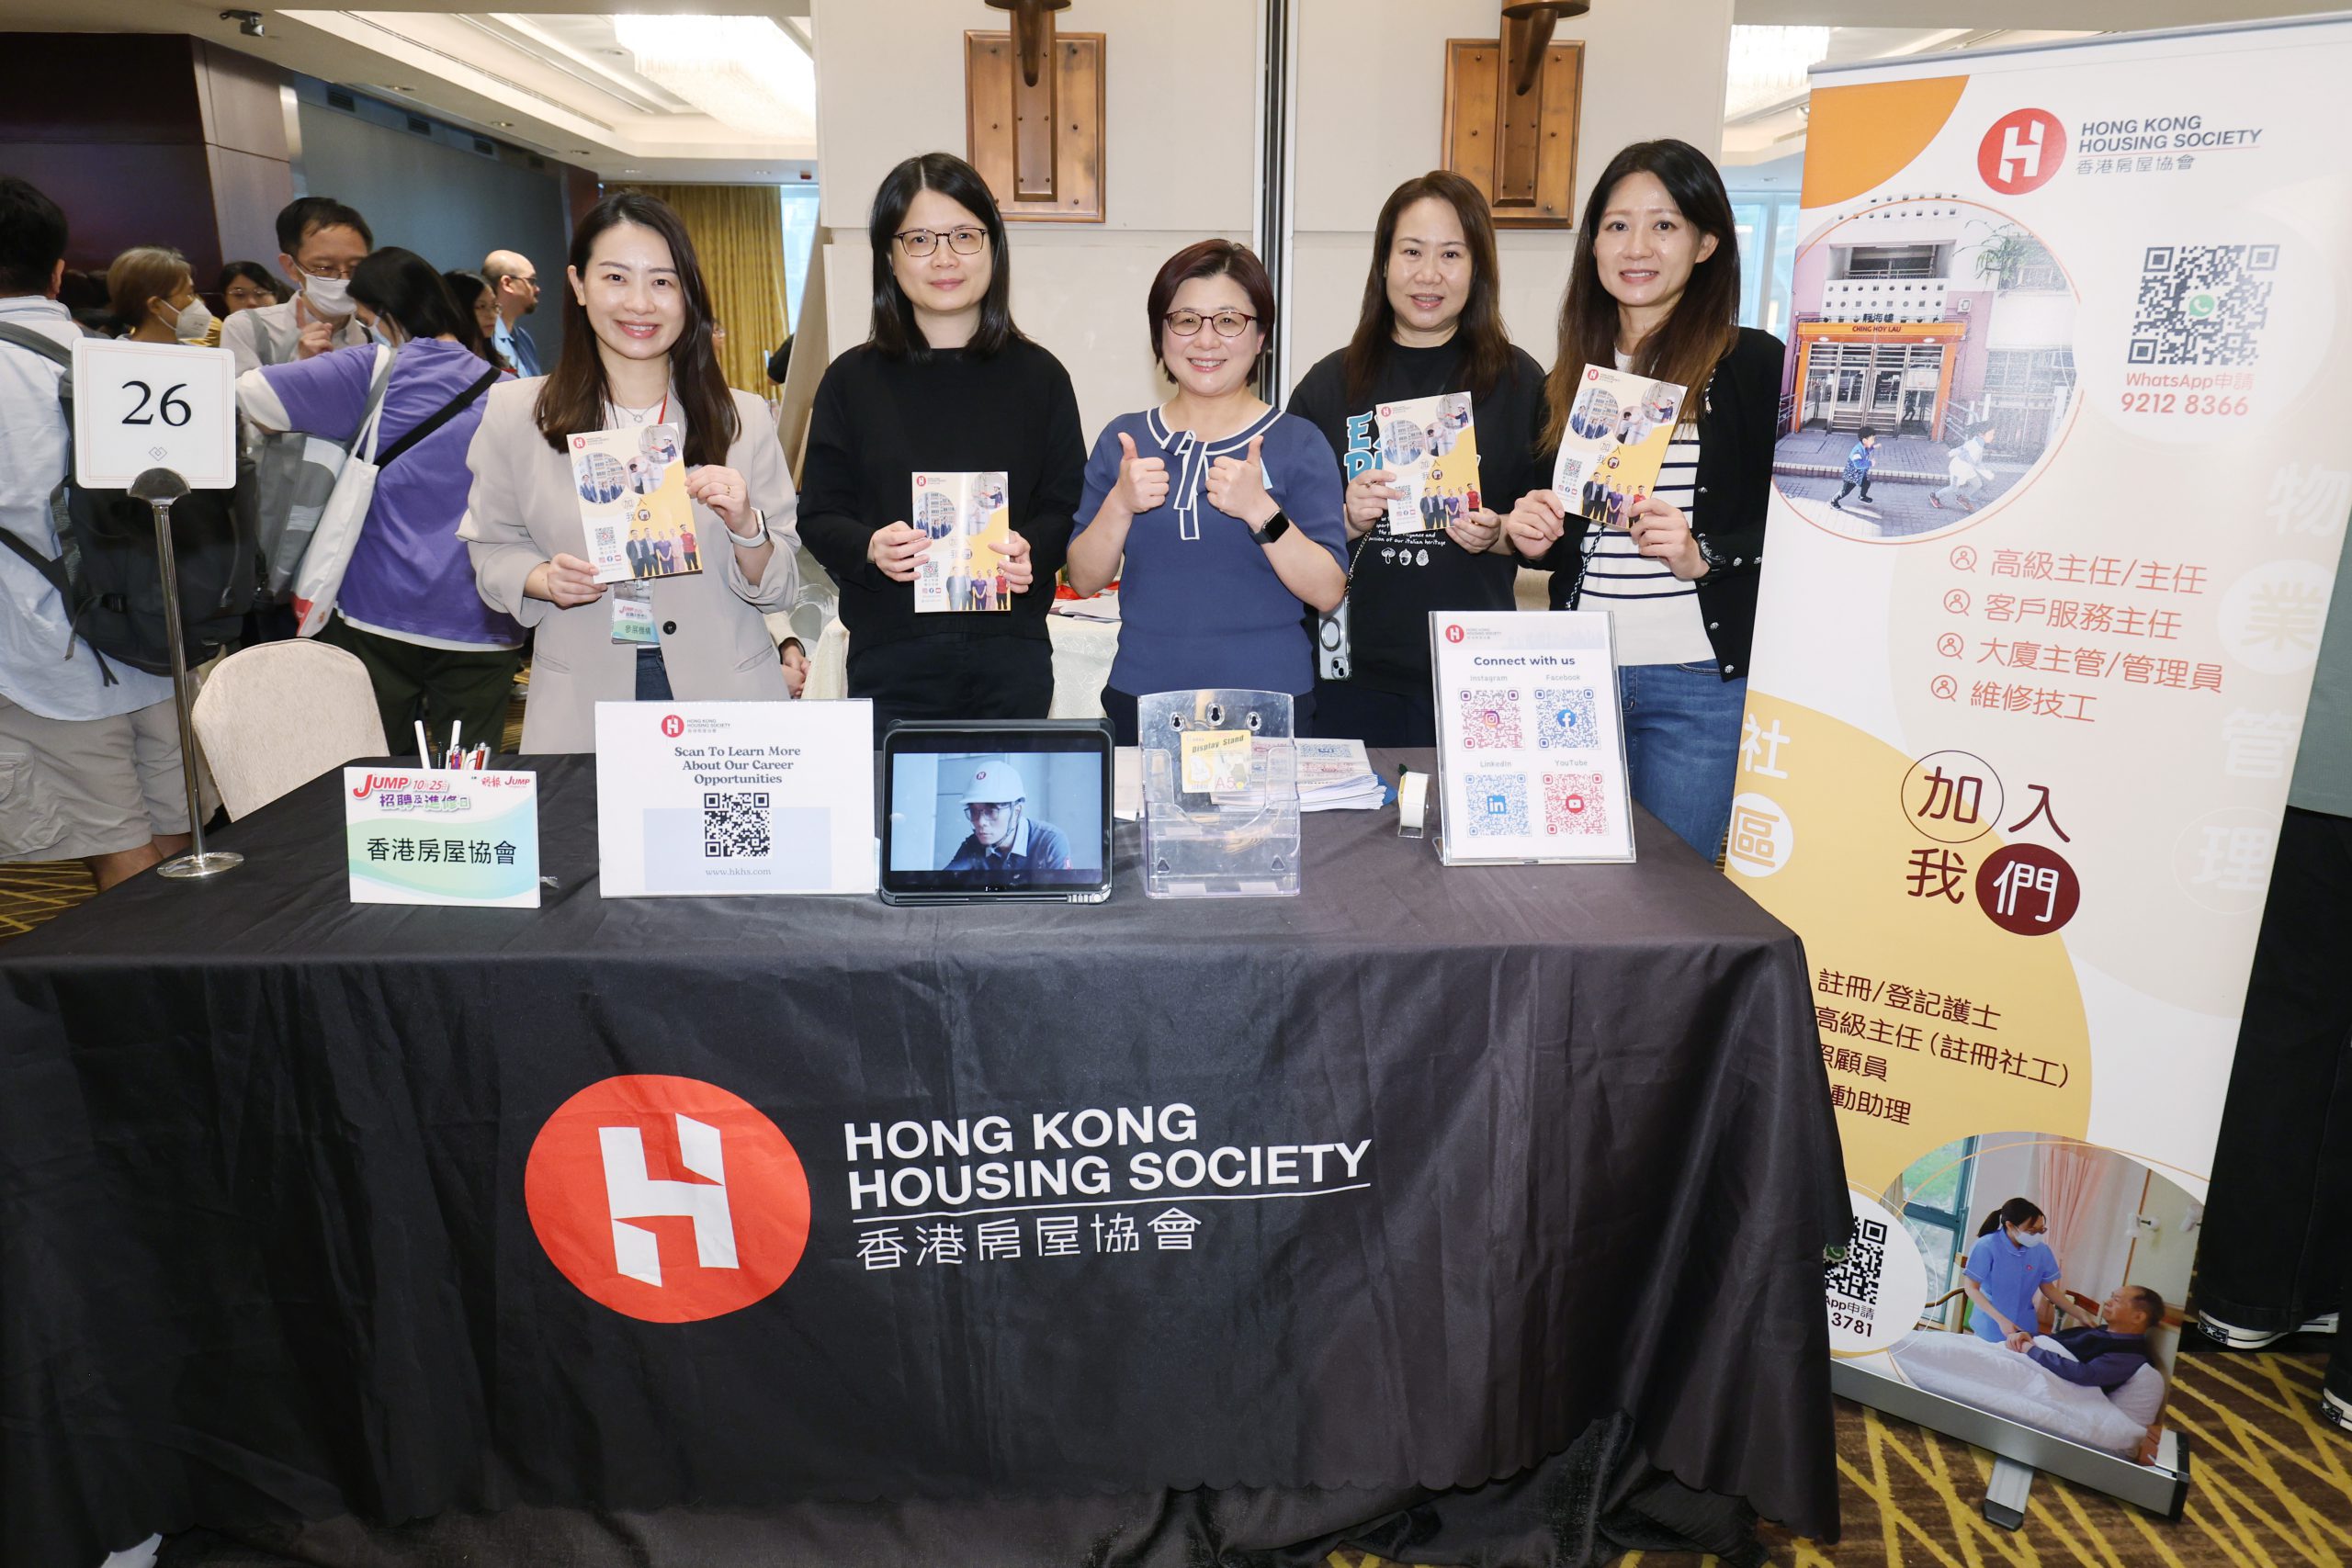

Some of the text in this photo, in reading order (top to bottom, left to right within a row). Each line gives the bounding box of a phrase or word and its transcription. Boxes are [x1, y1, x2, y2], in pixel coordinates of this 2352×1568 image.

[2081, 116, 2201, 136] HONG KONG
[2078, 129, 2263, 152] HOUSING SOCIETY
[2076, 154, 2195, 175] 香港房屋協會
[121, 380, 192, 427] 26
[2121, 392, 2248, 416] 9212 8366
[1990, 548, 2207, 594] 高級主任/主任
[1984, 593, 2182, 640] 客戶服務主任
[1474, 657, 1526, 666] Connect
[1529, 655, 1557, 665] with
[1976, 637, 2222, 694] 大廈主管/管理員
[1970, 680, 2098, 723] 維修技工
[674, 746, 801, 757] Scan To Learn More
[1192, 735, 1244, 753] Display Stand
[683, 761, 794, 770] About Our Career
[353, 774, 409, 797] JUMP
[504, 776, 530, 785] JUMP
[694, 773, 783, 786] Opportunities
[1917, 766, 2071, 843] 加入
[367, 838, 516, 864] 香港房屋協會
[705, 868, 772, 876] www.hkhs.com
[1905, 848, 2060, 923] 我們
[1817, 968, 2001, 1031] 註冊/登記護士
[843, 1103, 1198, 1162] HONG KONG
[847, 1138, 1373, 1212] HOUSING SOCIETY
[855, 1206, 1203, 1271] 香港房屋協會
[1831, 1312, 1872, 1337] 3781
